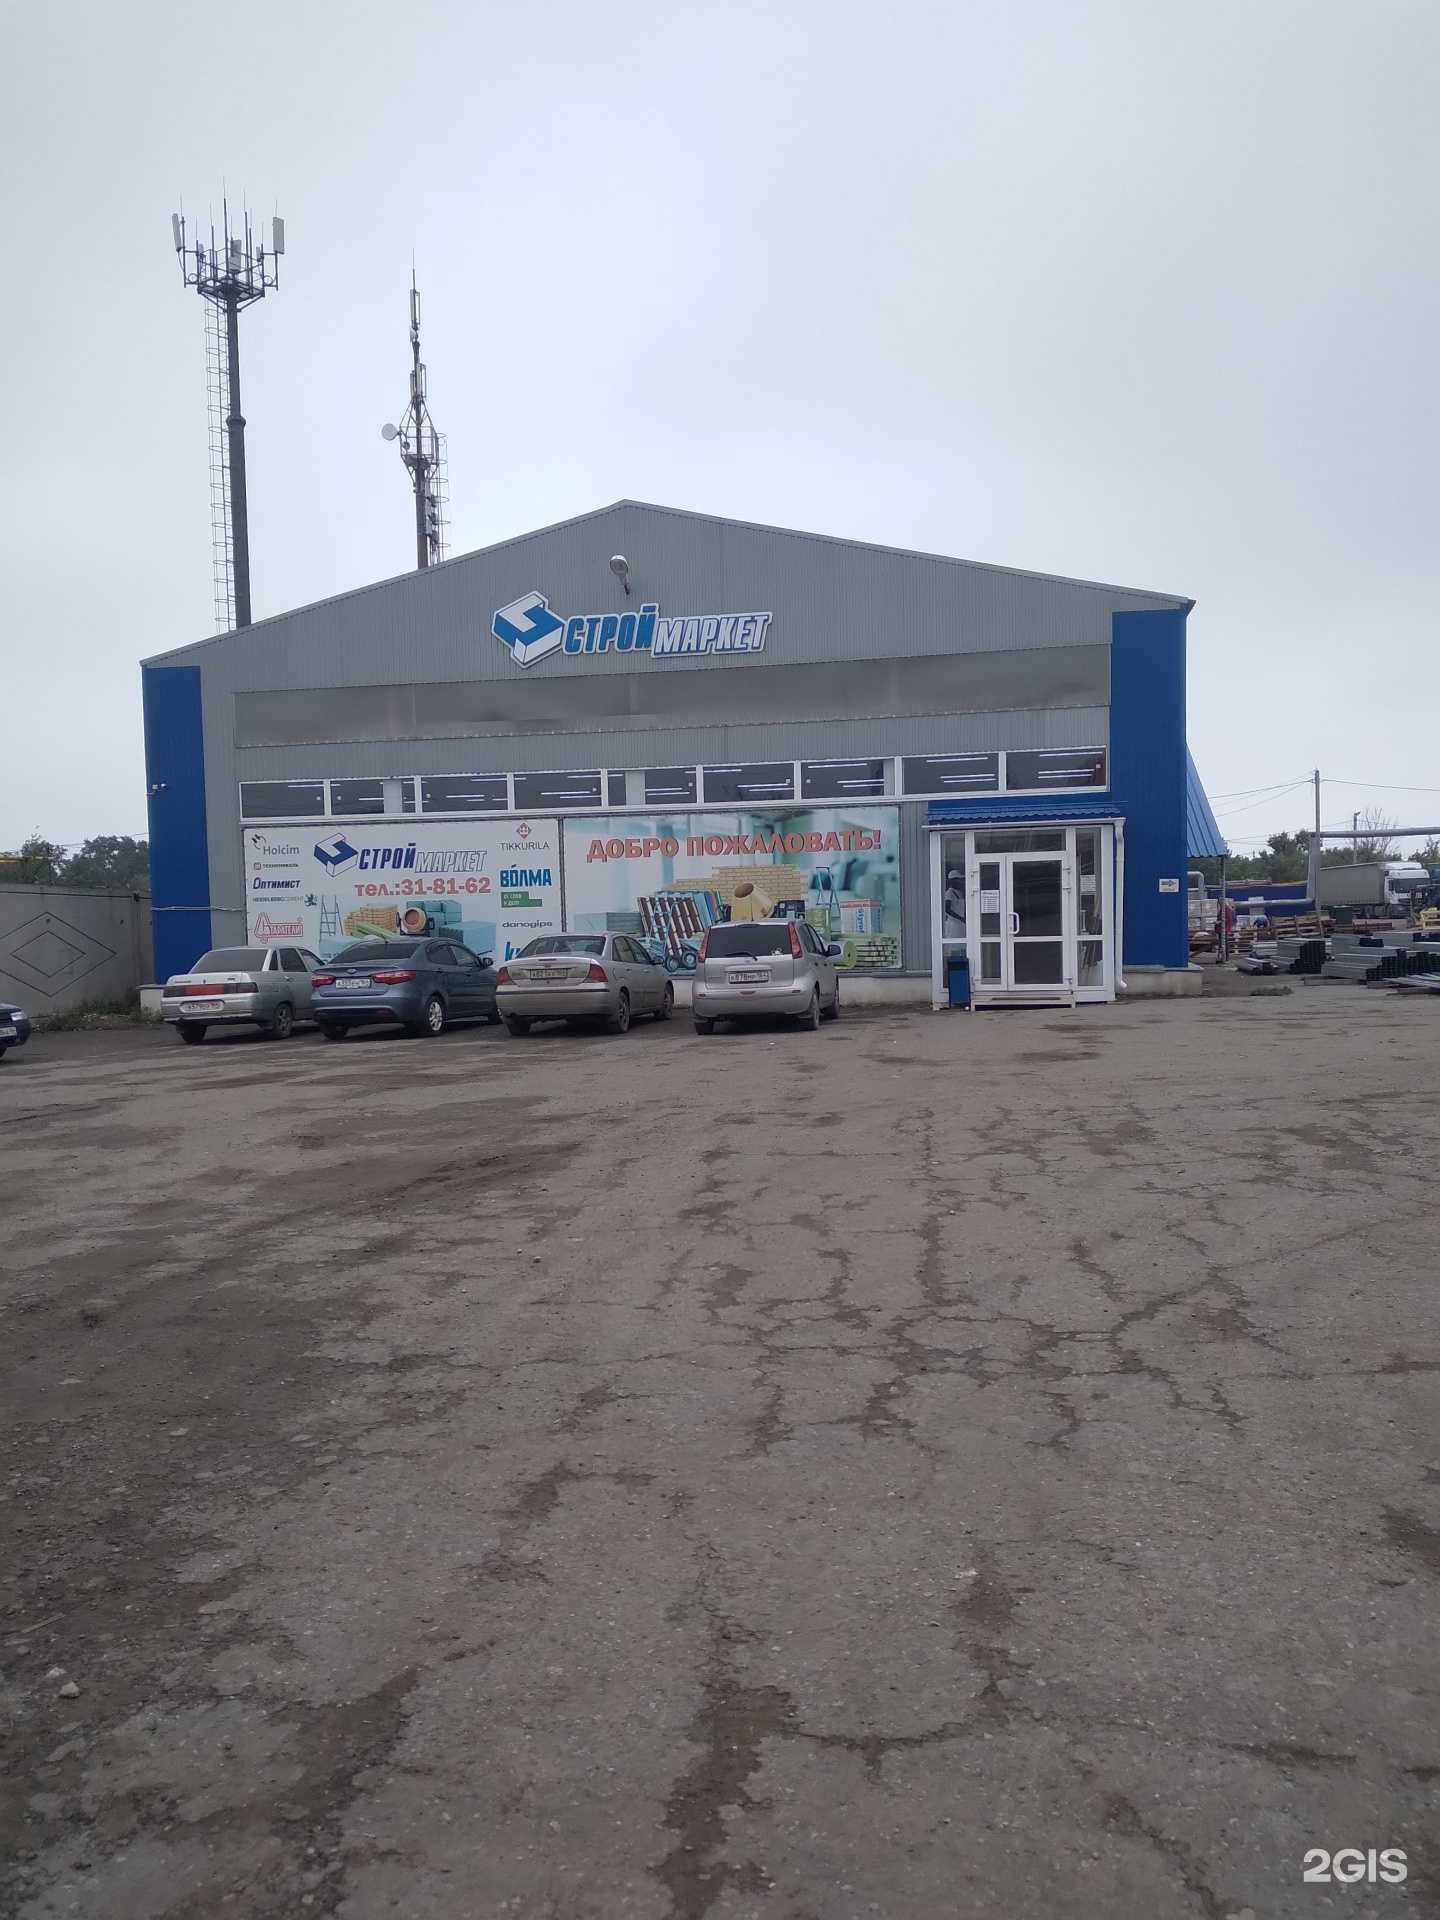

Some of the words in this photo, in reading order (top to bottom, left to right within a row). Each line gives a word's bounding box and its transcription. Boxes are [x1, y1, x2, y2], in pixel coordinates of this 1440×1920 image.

[263, 844, 300, 856] Holcim
[500, 841, 550, 851] TIKKURILA
[586, 838, 680, 863] ДОБРО
[686, 829, 882, 858] ПОЖАЛОВАТЬ!
[500, 864, 552, 888] ВОЛМА
